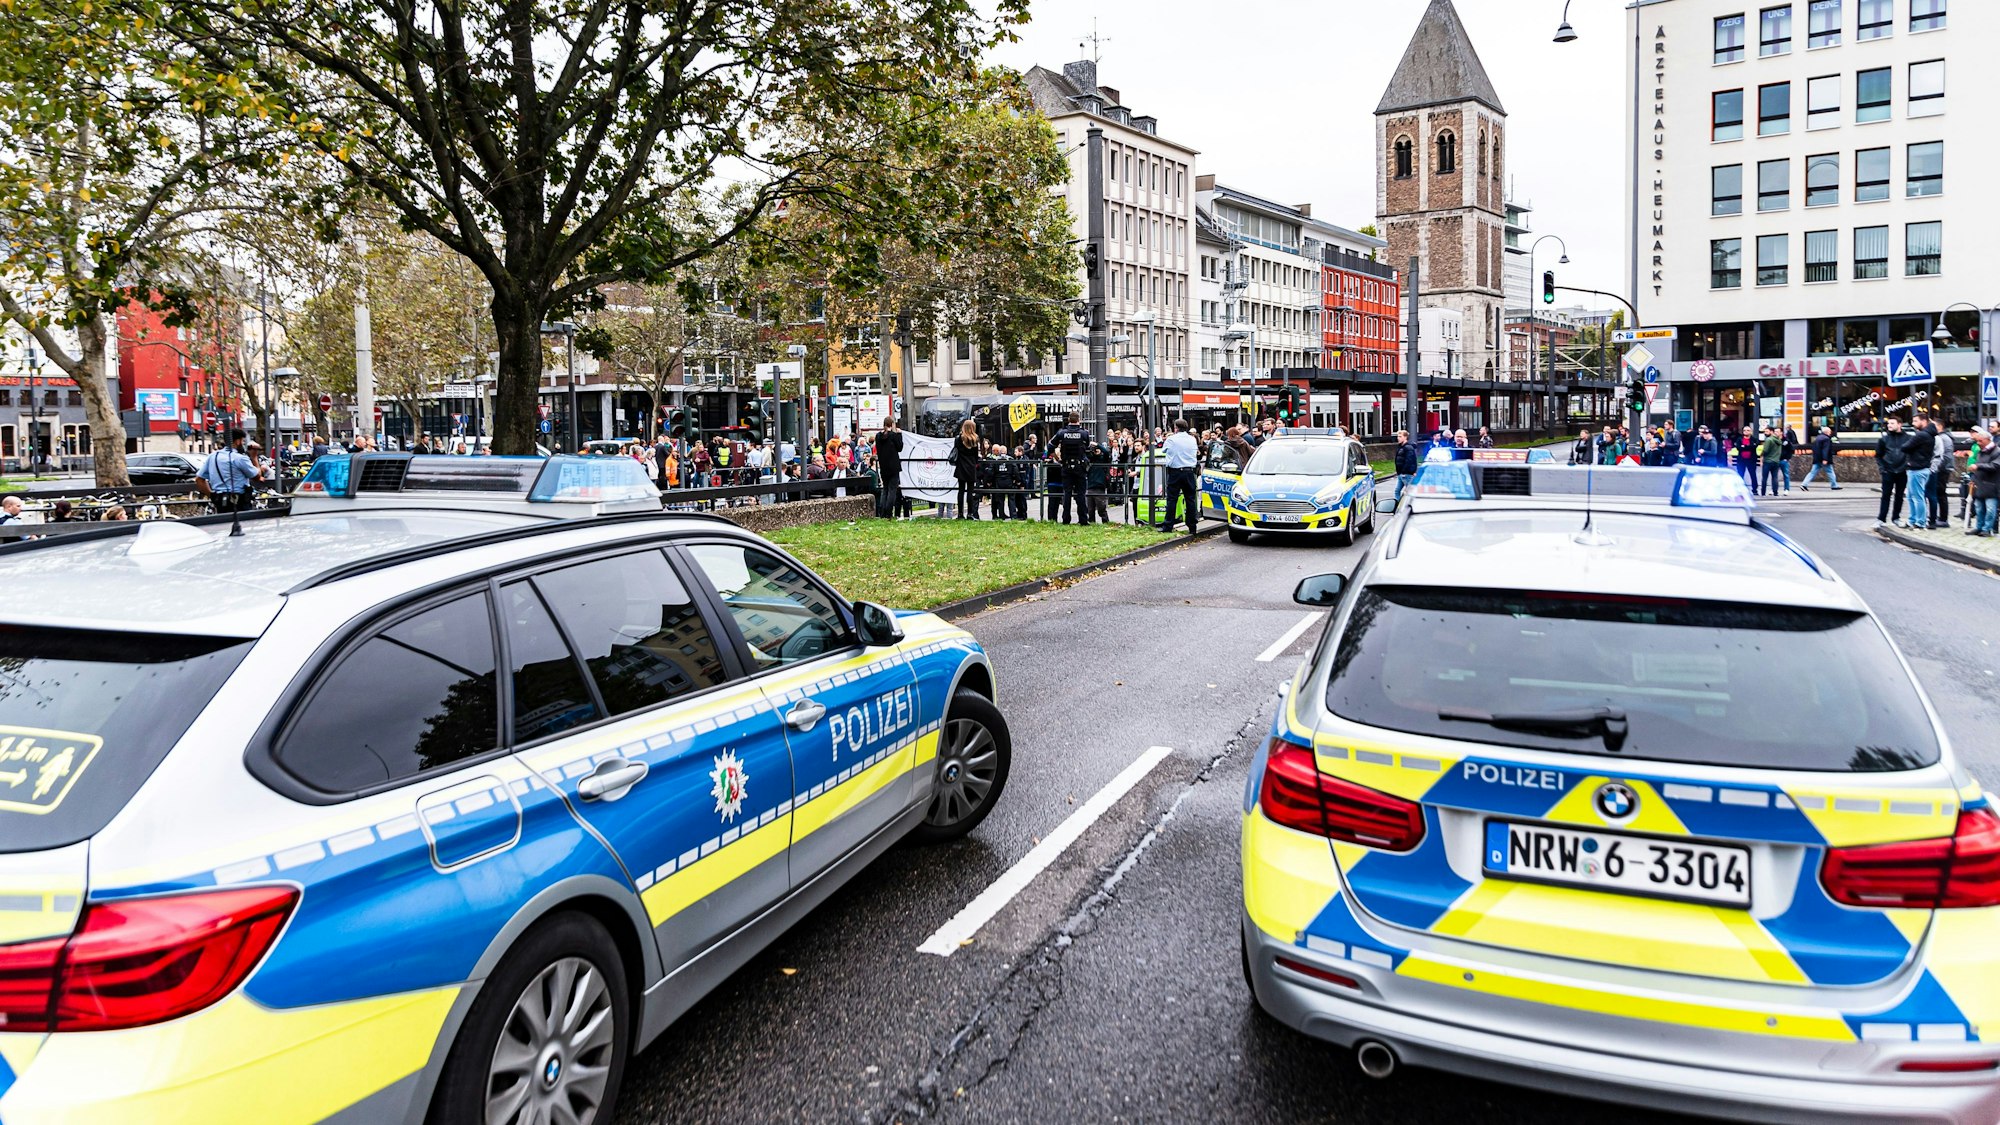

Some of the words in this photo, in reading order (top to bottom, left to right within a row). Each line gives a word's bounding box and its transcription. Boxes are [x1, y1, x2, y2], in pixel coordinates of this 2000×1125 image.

[1721, 17, 1741, 27] ZEIG
[1768, 9, 1786, 19] UNS
[1813, 1, 1839, 11] DEINE
[1654, 25, 1666, 160] ÄRZTEHAUS
[1652, 179, 1663, 297] HEUMARKT
[1758, 363, 1792, 377] Café
[1799, 360, 1819, 376] IL
[1840, 392, 1880, 414] ESPRESSO
[1212, 482, 1231, 492] POLIZ
[829, 684, 912, 762] POLIZEI
[1463, 762, 1564, 790] POLIZEI
[1510, 829, 1579, 873] NRW
[1604, 841, 1745, 892] 6-3304
